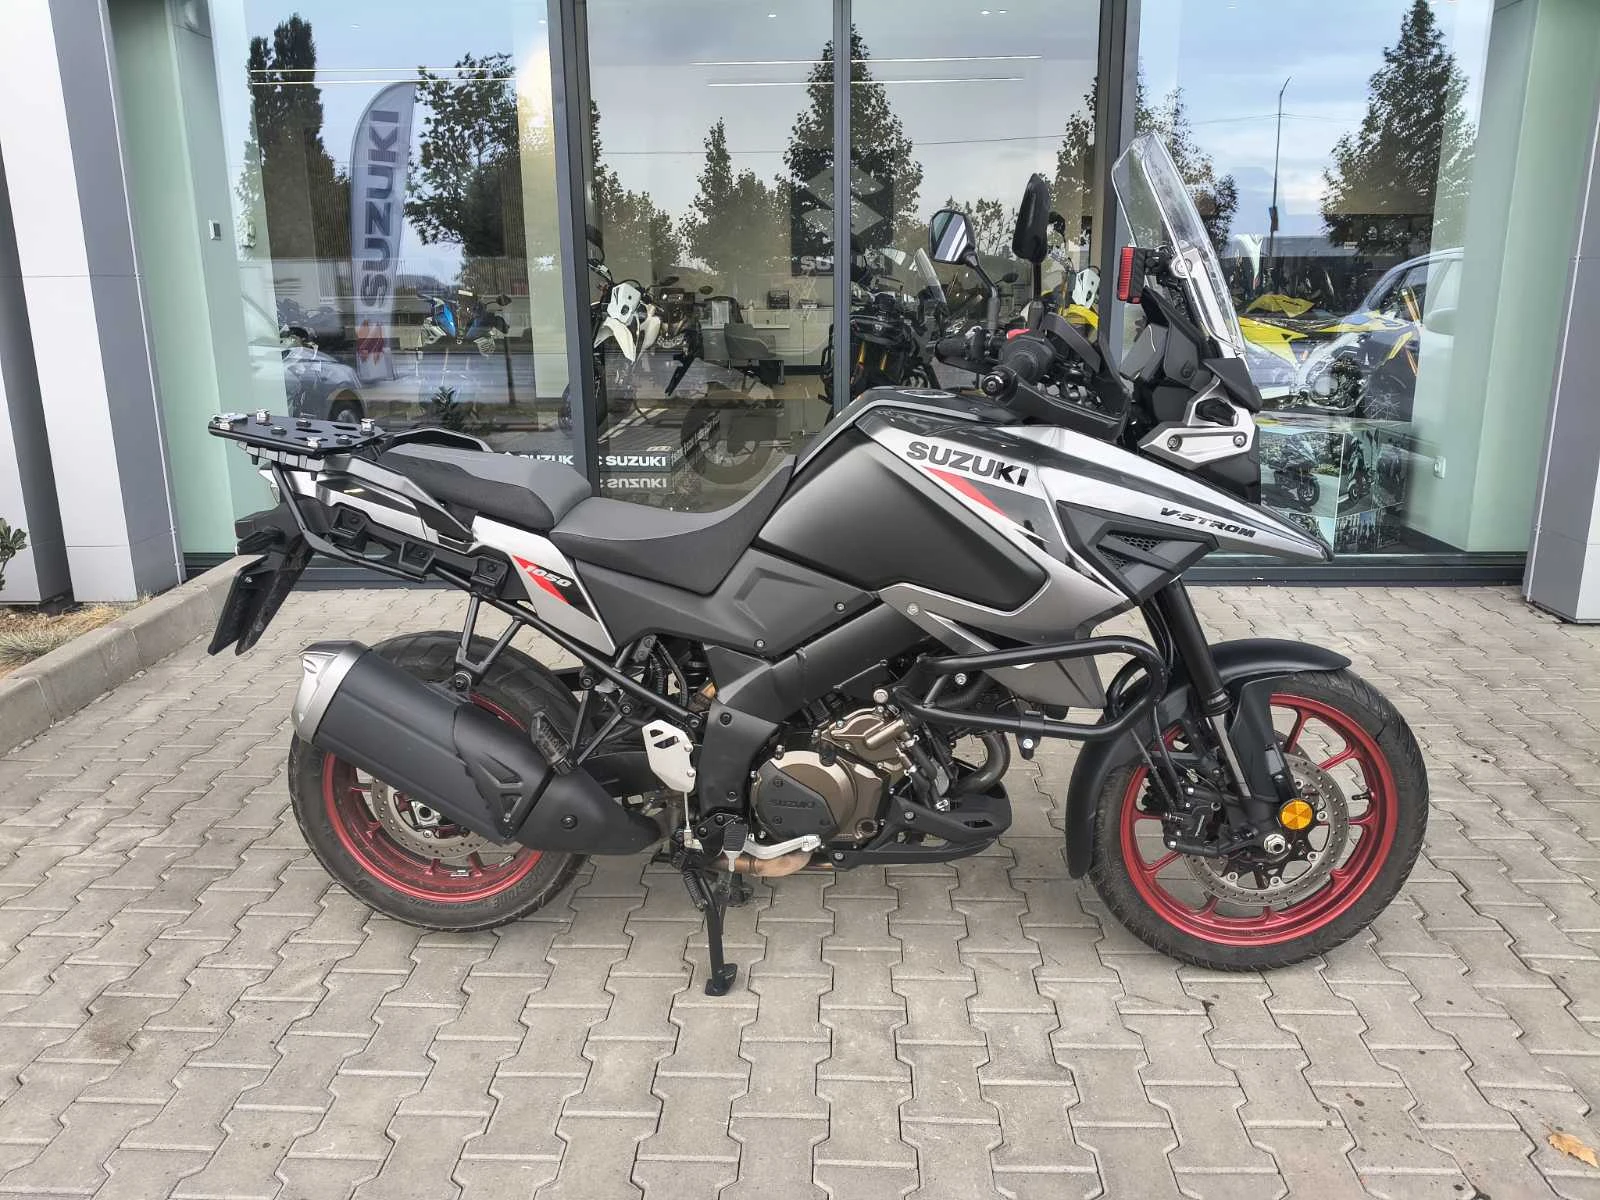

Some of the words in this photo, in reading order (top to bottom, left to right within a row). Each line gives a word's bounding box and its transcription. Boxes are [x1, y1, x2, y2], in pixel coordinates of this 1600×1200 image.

[360, 110, 399, 307] SUZUKI
[605, 455, 667, 467] SUZUKI
[906, 441, 1029, 487] SUZUKI
[1160, 507, 1256, 538] V-STROM
[526, 564, 573, 587] 1050
